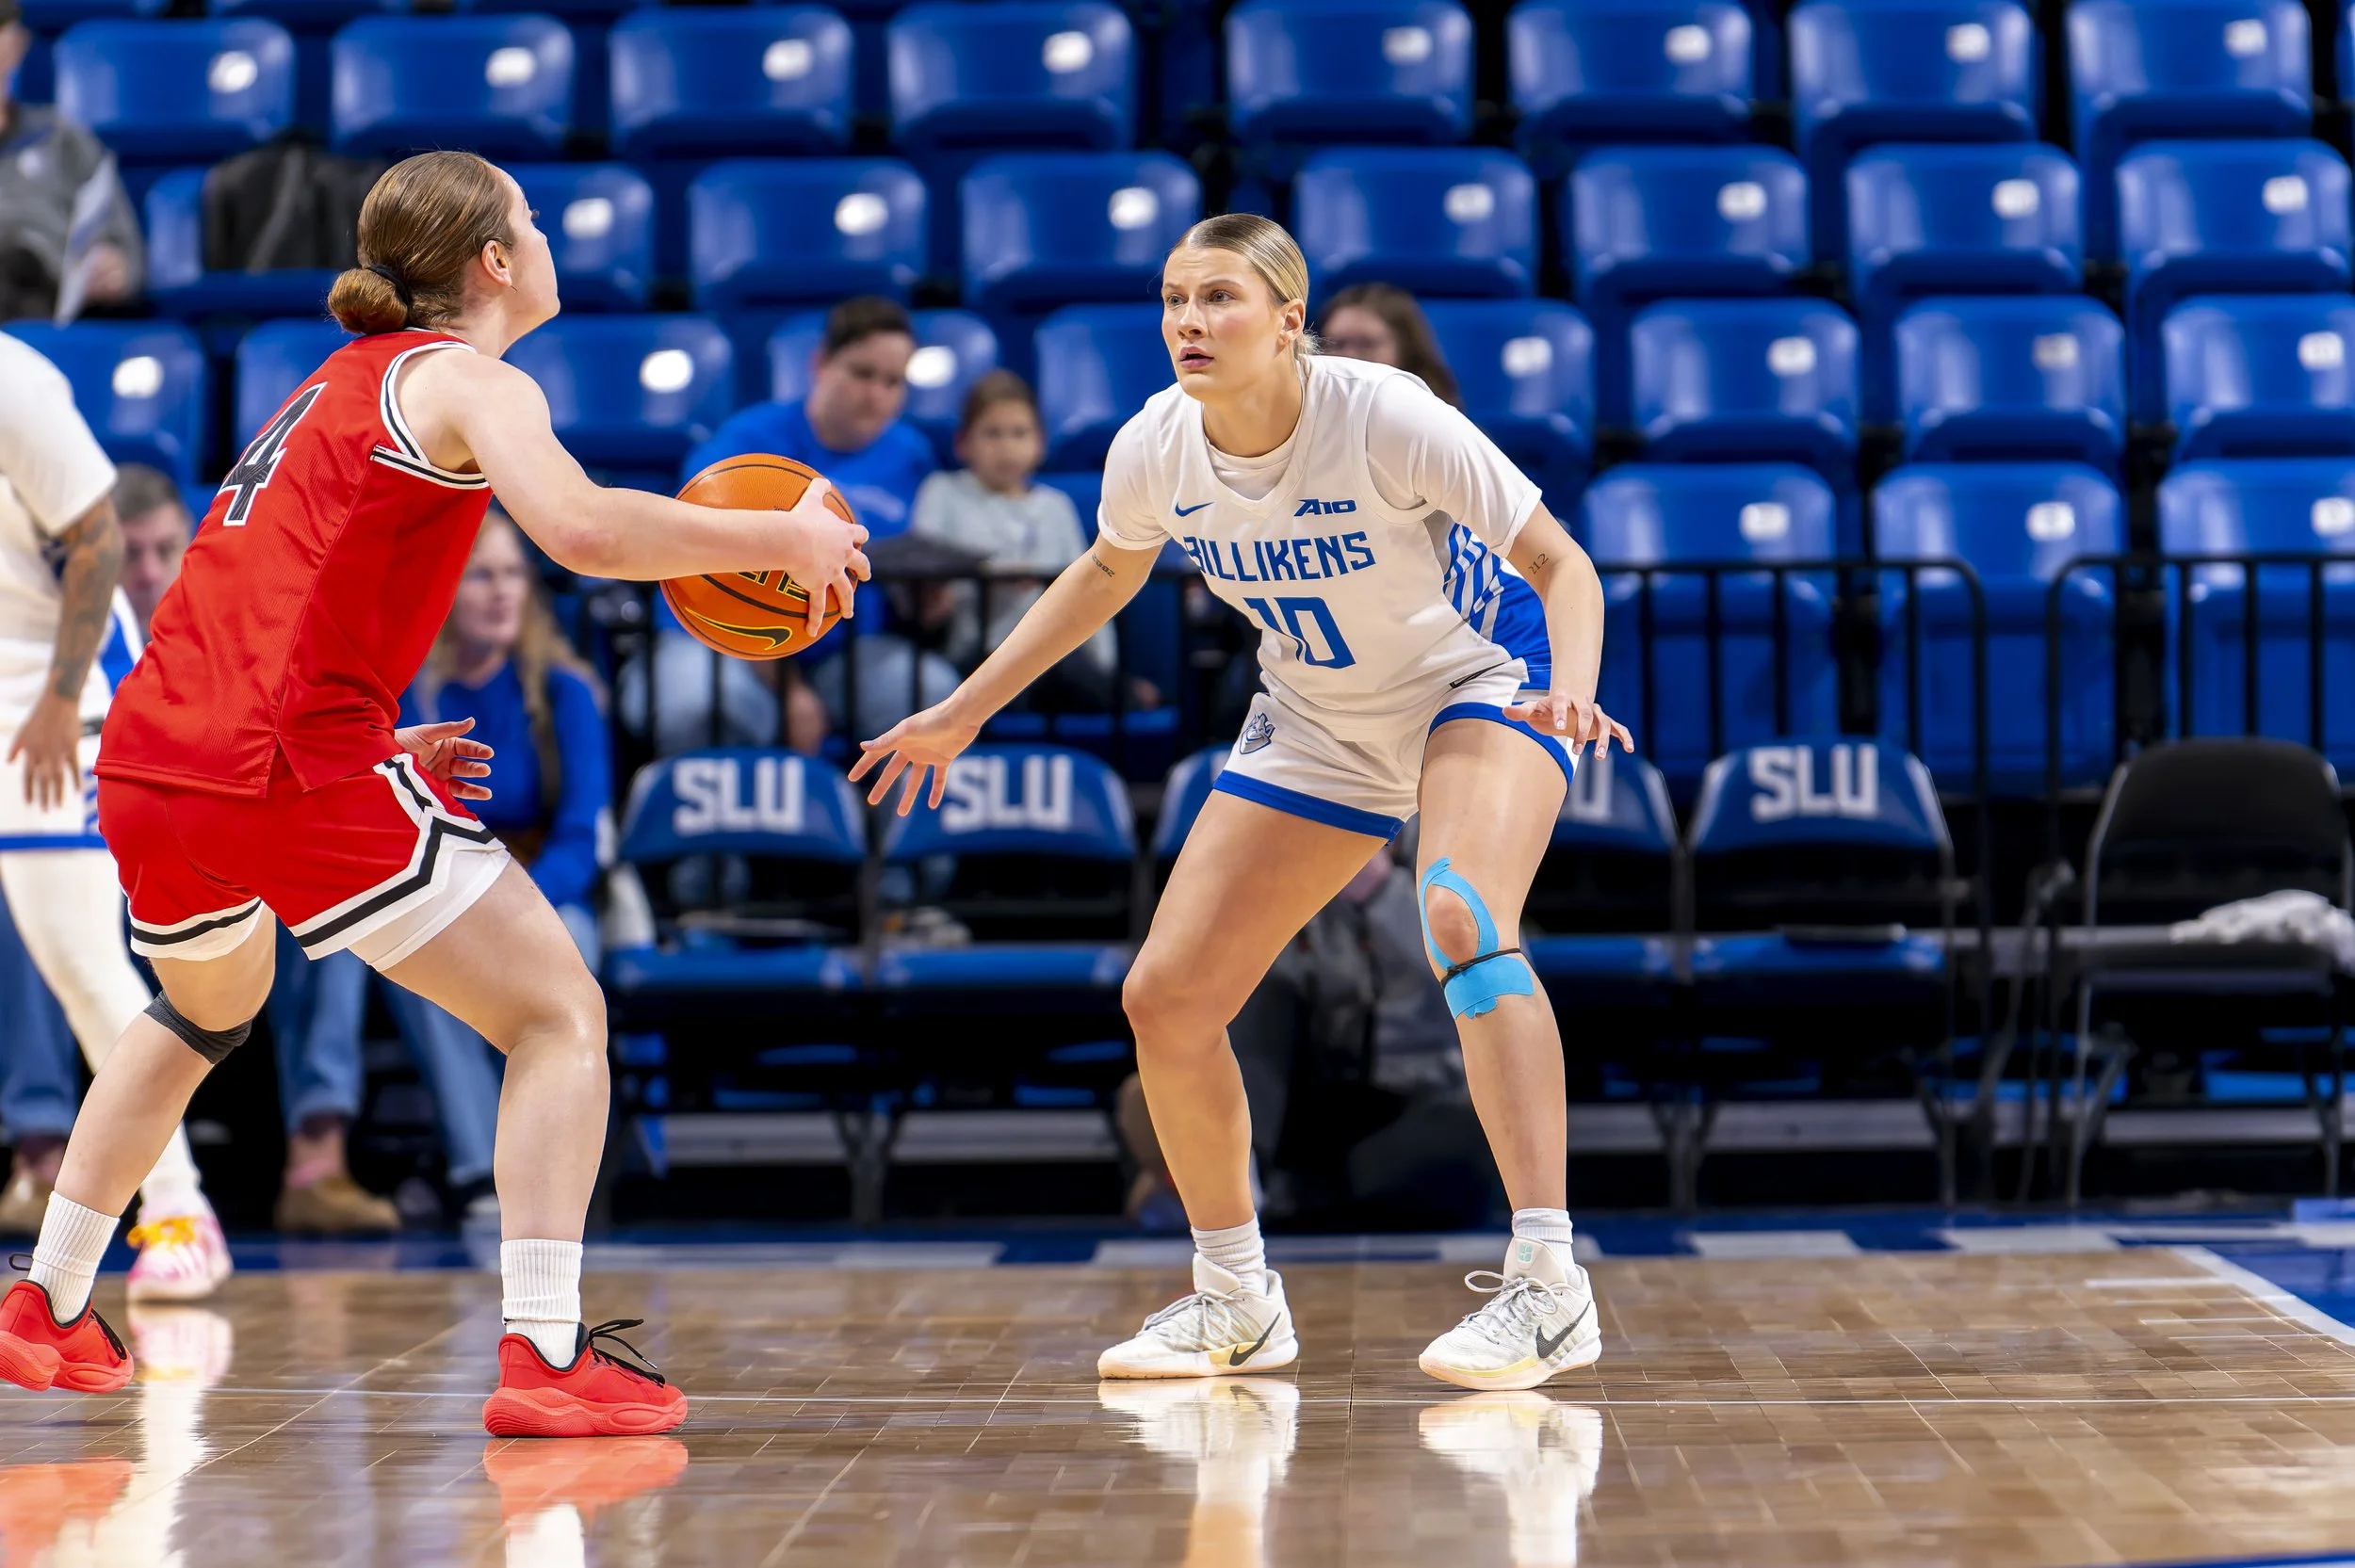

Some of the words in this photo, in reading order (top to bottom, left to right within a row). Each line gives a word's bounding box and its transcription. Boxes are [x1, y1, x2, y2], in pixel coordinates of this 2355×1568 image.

[217, 380, 328, 527] 4
[1182, 530, 1376, 582] BILLIKENS
[1243, 596, 1356, 670] 10
[673, 756, 804, 834] SLU
[941, 753, 1074, 833] SLU
[1748, 744, 1879, 822] SLU
